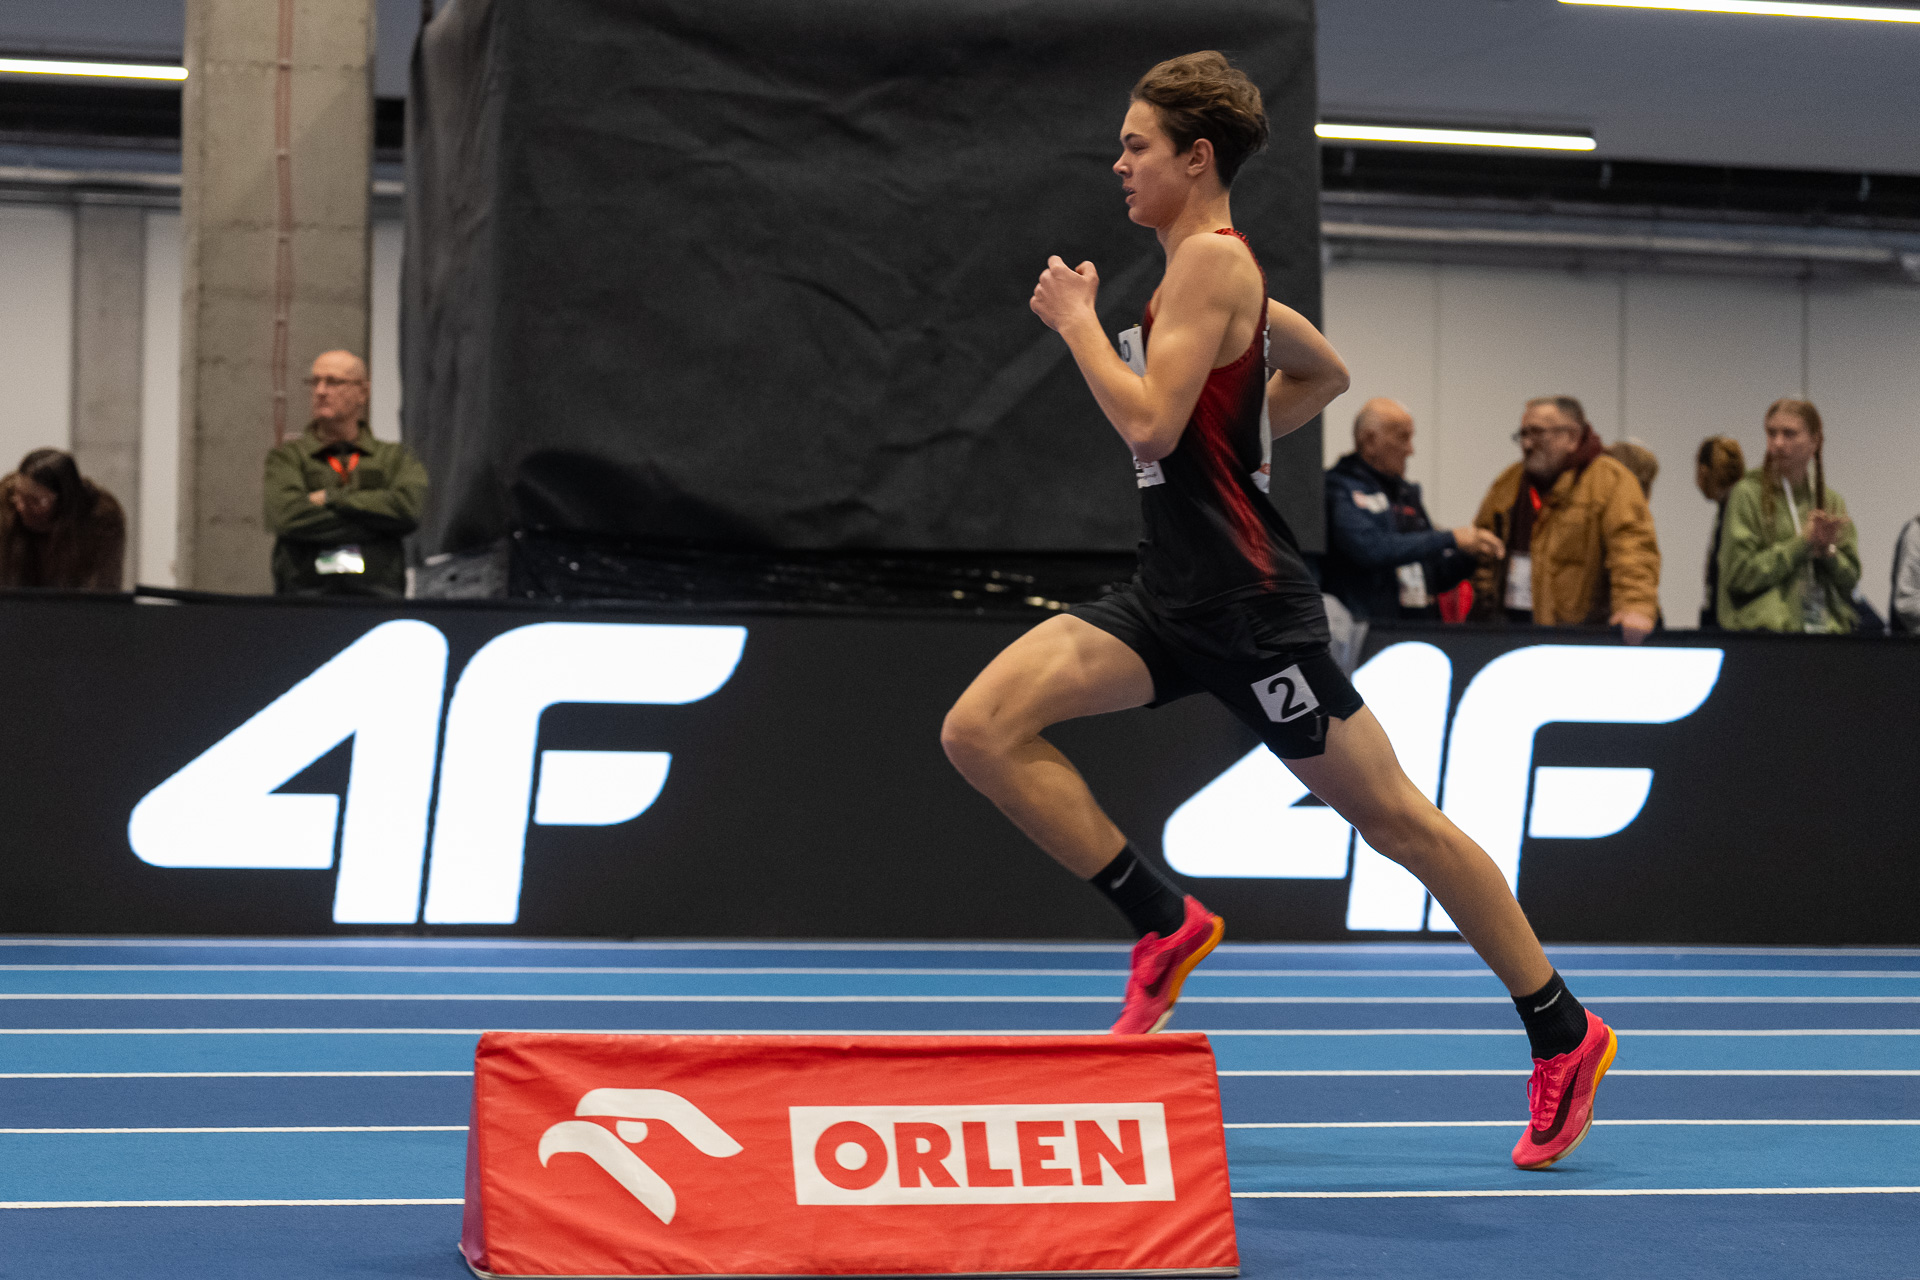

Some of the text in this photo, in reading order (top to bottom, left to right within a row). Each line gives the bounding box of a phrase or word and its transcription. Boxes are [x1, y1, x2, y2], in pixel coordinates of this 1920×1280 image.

[129, 620, 746, 923] 4F
[1163, 642, 1723, 931] 4F
[1267, 676, 1308, 720] 2
[814, 1120, 1147, 1190] ORLEN
